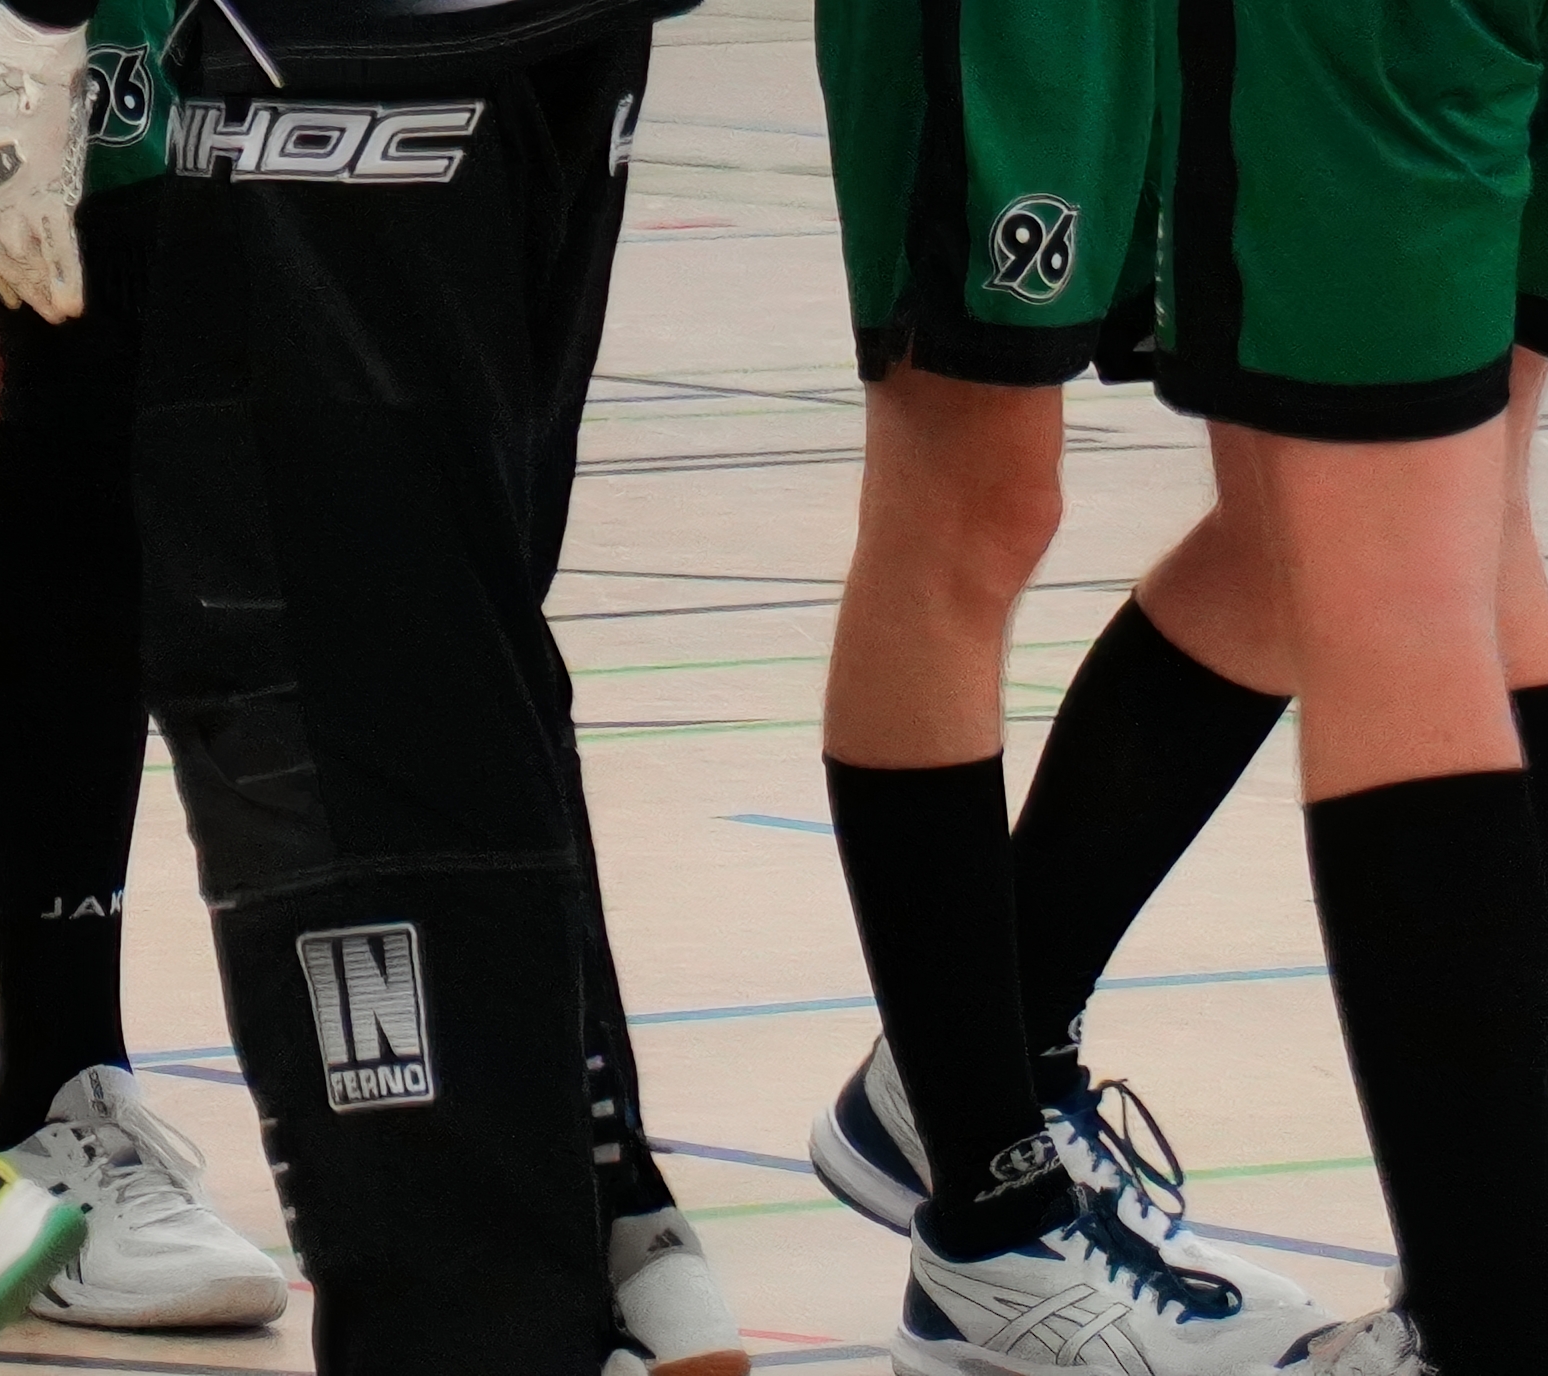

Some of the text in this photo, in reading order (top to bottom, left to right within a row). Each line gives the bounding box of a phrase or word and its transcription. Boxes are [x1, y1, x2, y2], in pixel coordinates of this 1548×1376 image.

[993, 205, 1076, 293] 96
[305, 934, 421, 1065] IN
[331, 1062, 427, 1102] FERNO
